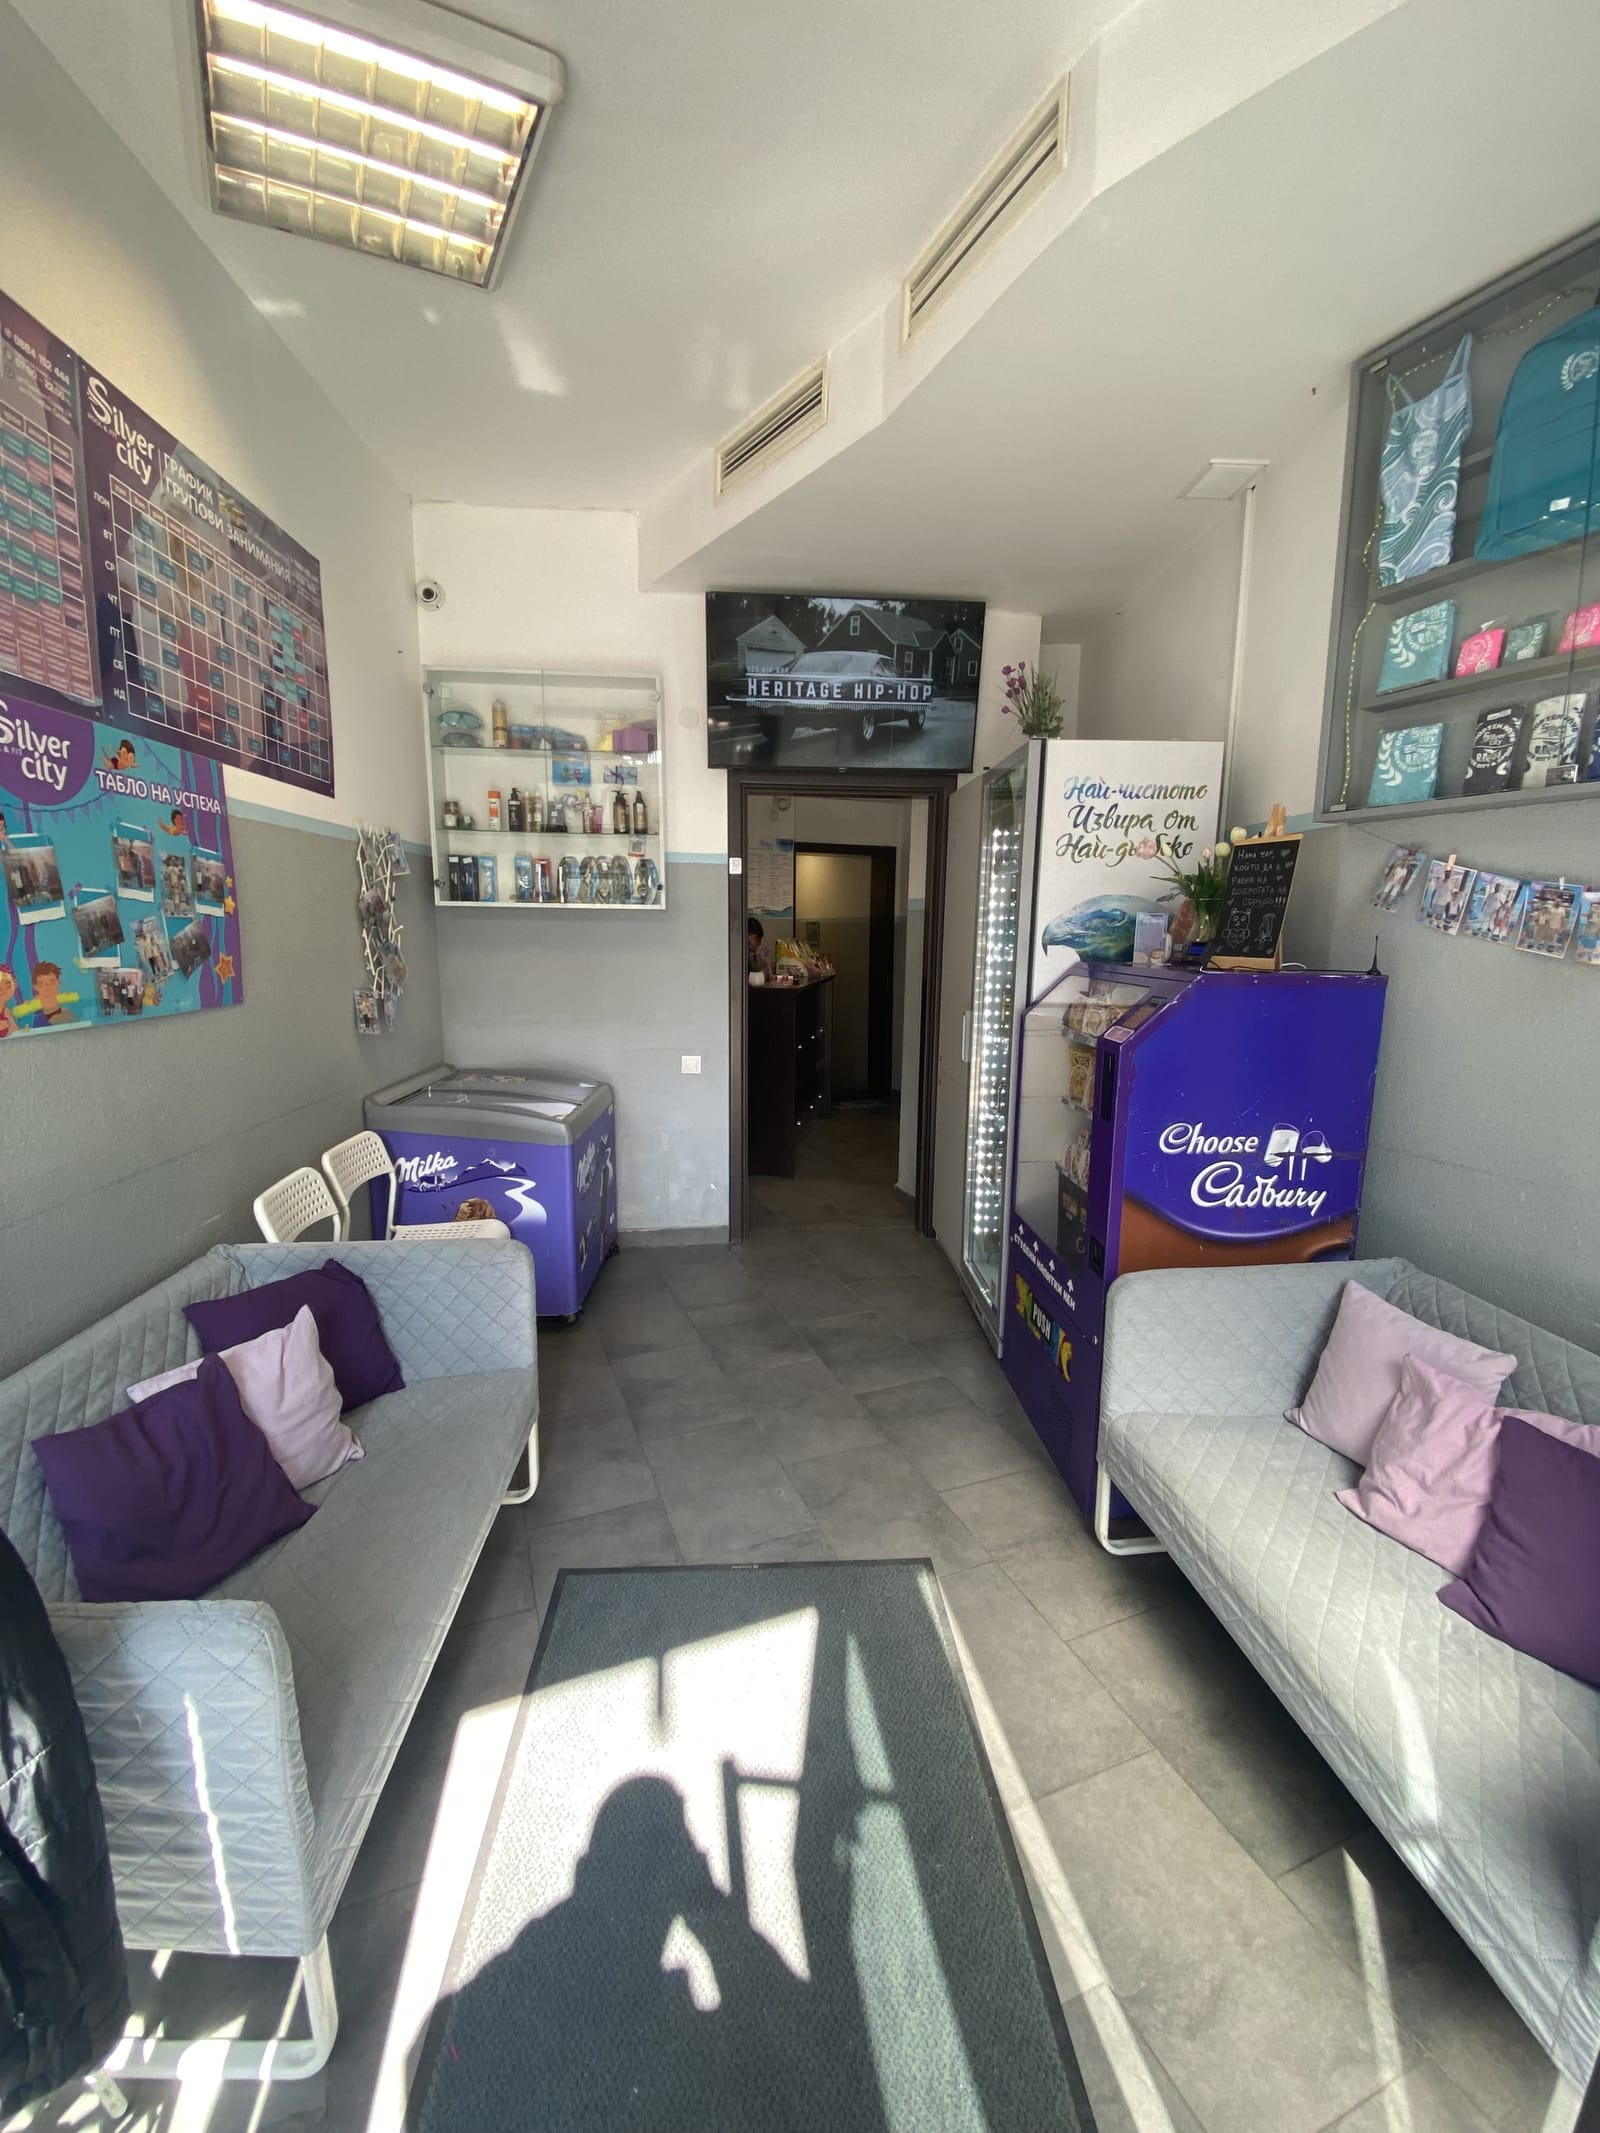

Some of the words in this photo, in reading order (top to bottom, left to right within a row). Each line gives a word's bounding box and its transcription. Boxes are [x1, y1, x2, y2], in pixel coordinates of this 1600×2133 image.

[87, 377, 155, 460] Silver
[116, 441, 151, 485] city
[163, 452, 214, 506] ГРАФИК
[93, 491, 111, 510] ПОН
[103, 528, 113, 541] ВТ
[165, 476, 225, 534] ГРУПОВИ
[226, 523, 292, 587] ЗАНИМАНИЯ
[104, 561, 116, 572] СР
[107, 592, 118, 604] ЧТ
[109, 626, 121, 640] ПТ
[112, 658, 124, 671] СБ
[113, 687, 126, 700] НД
[747, 677, 843, 699] HERITAGE
[853, 683, 933, 701] HIP-HOP
[21, 751, 68, 791] city
[1063, 775, 1208, 801] Най-чистото
[95, 770, 148, 798] ТАБЛО
[151, 783, 172, 804] НА
[174, 789, 223, 814] УСПЕХА
[1067, 803, 1156, 837] Извира
[1056, 833, 1193, 868] Най-дъбко
[1159, 1121, 1259, 1155] Choose
[395, 1151, 459, 1183] Milka
[1190, 1160, 1328, 1217] Cadbury
[1032, 1303, 1052, 1341] PUSH
